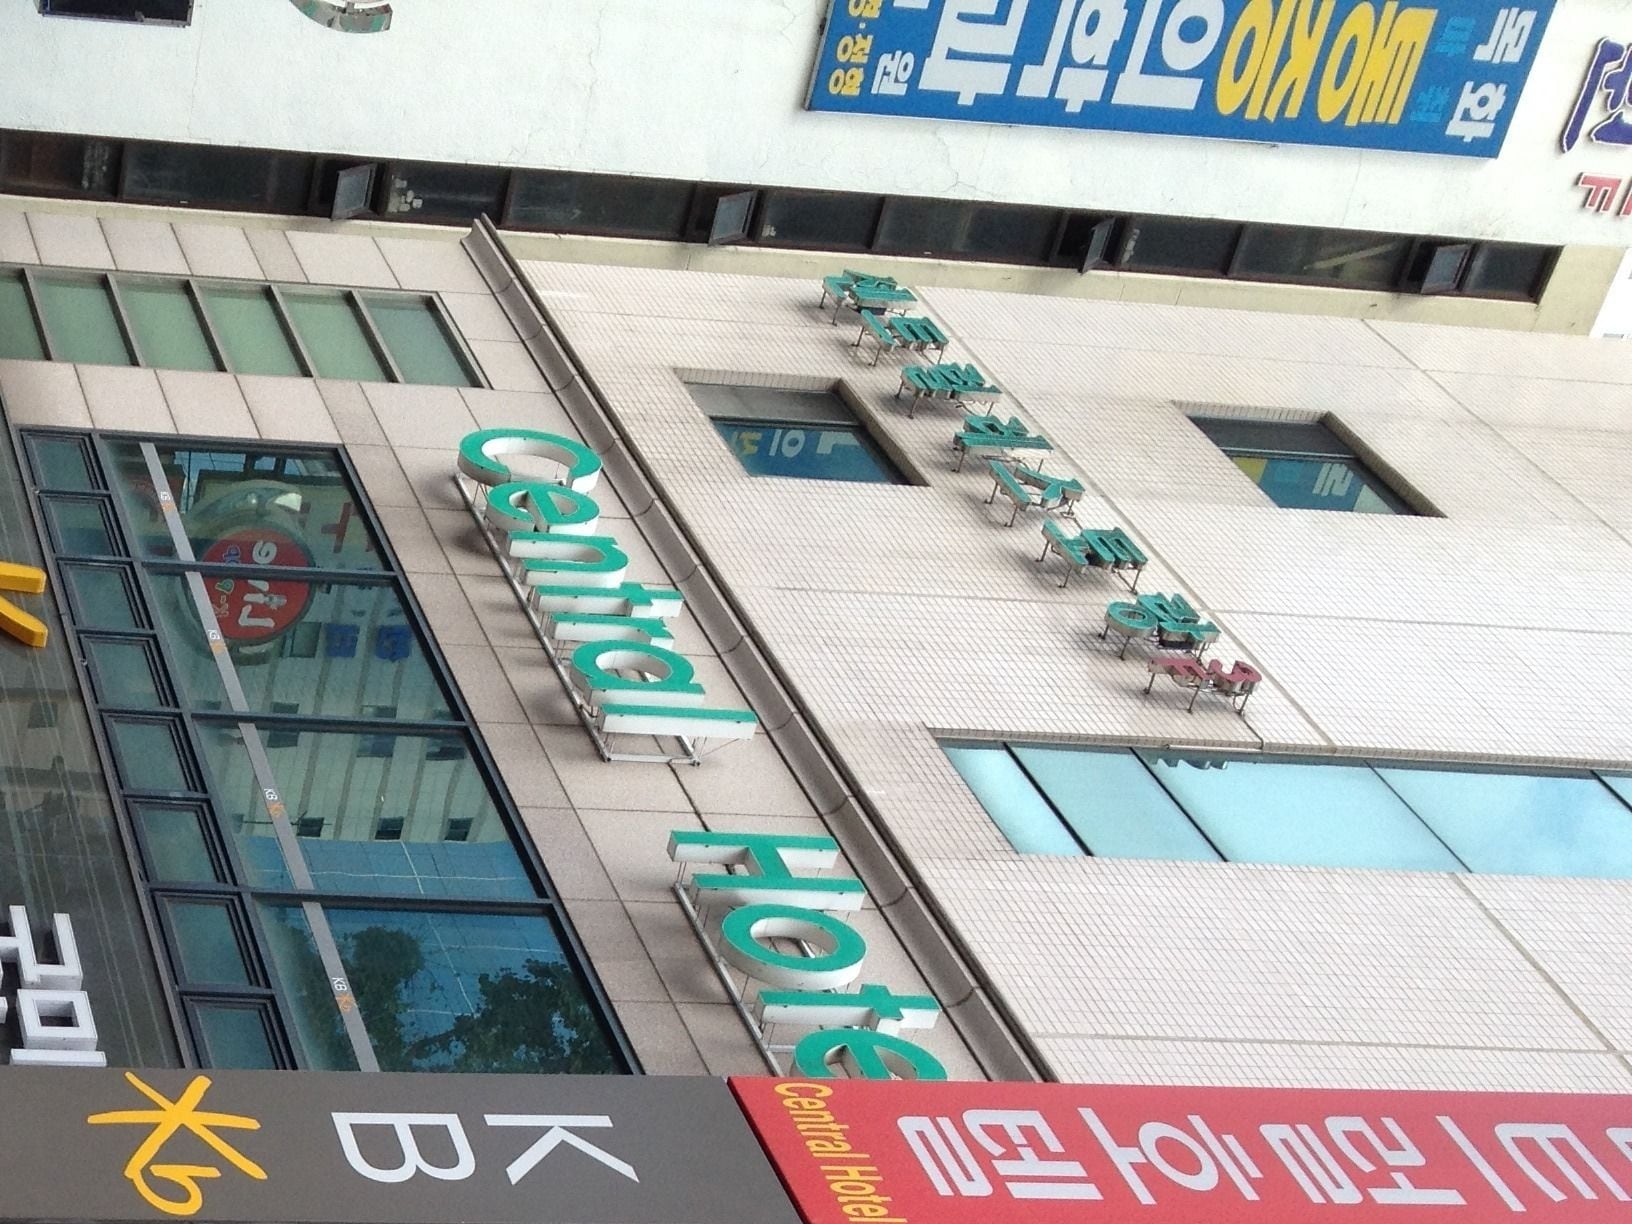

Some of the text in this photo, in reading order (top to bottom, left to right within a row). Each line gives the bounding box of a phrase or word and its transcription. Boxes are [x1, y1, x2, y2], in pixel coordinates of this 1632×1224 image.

[1445, 7, 1538, 142] 목화
[457, 428, 948, 1080] Central Hote
[774, 1082, 907, 1223] Central Hotel
[897, 1107, 1632, 1213] 트럴호텔
